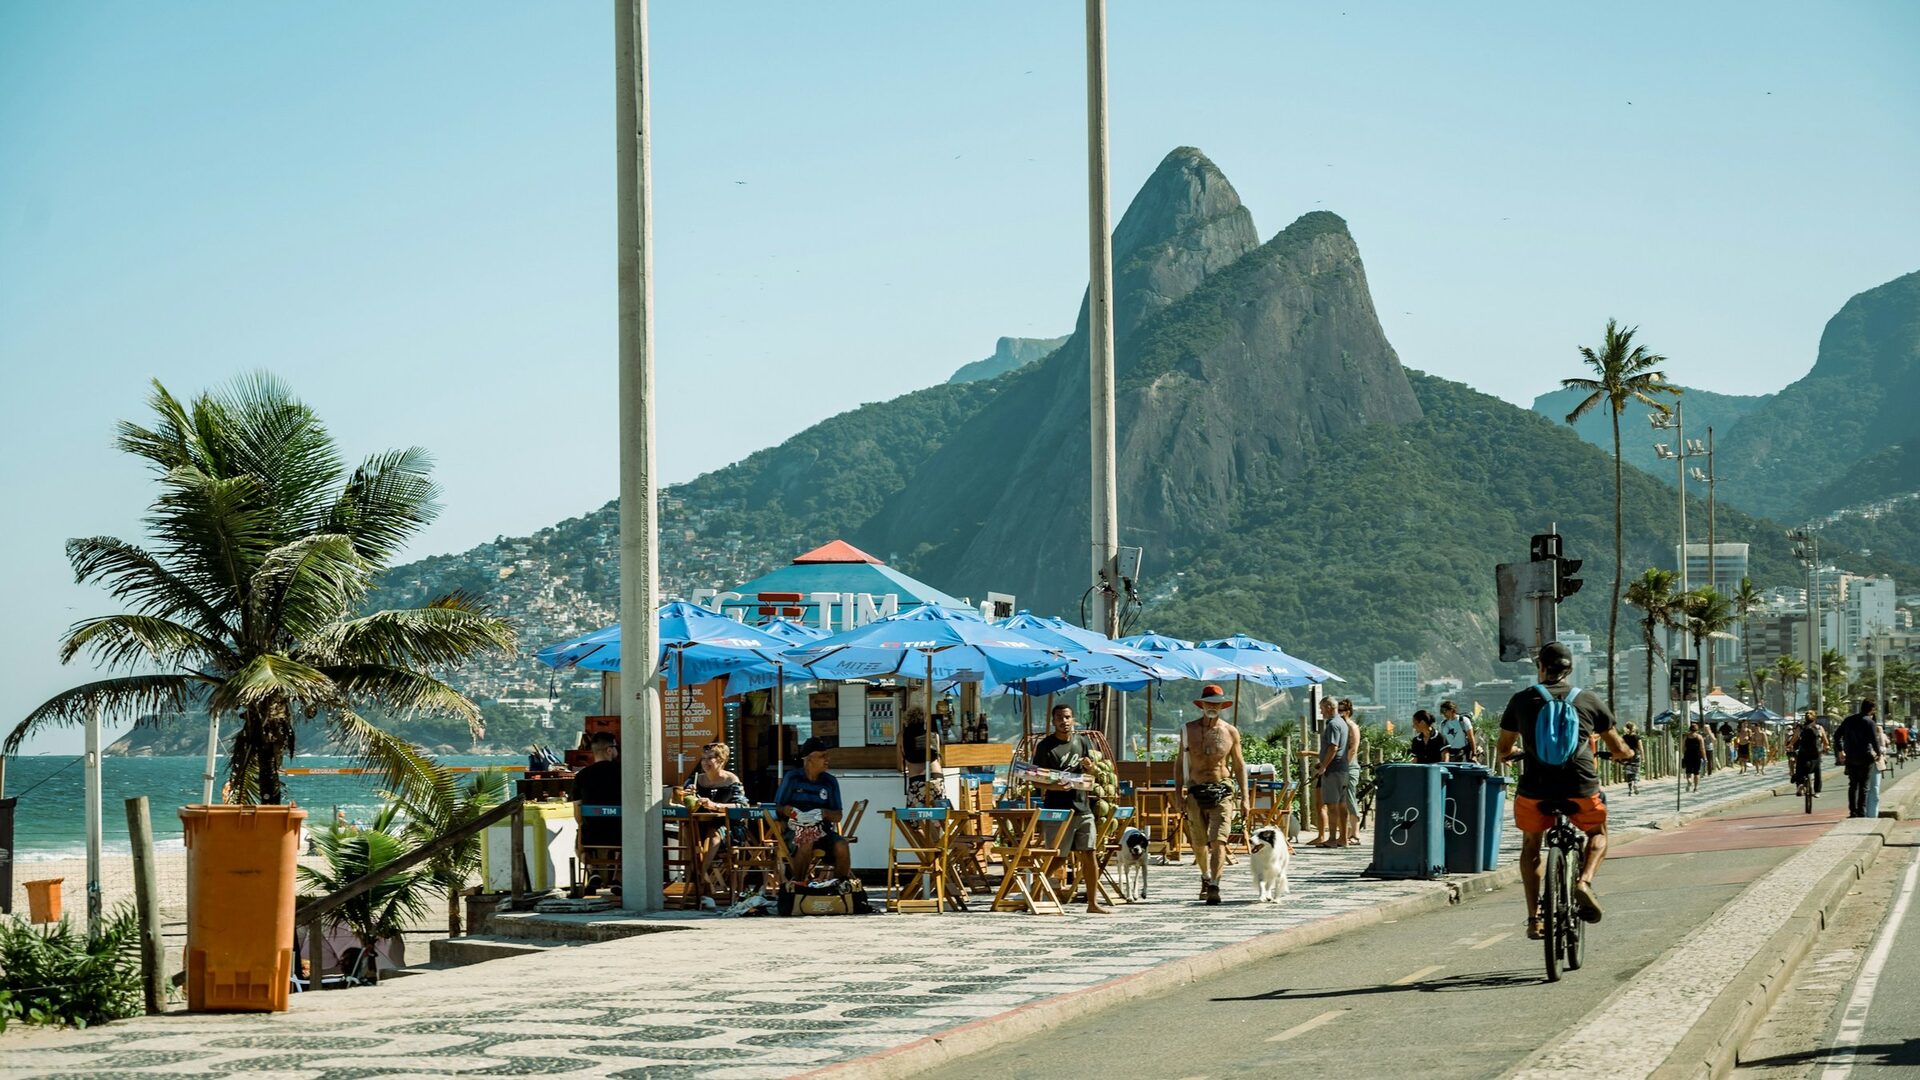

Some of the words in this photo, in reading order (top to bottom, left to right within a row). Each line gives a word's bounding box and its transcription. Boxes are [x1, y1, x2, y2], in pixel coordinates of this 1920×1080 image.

[810, 592, 898, 631] TIM
[728, 639, 762, 647] TIM
[903, 640, 936, 648] TIM
